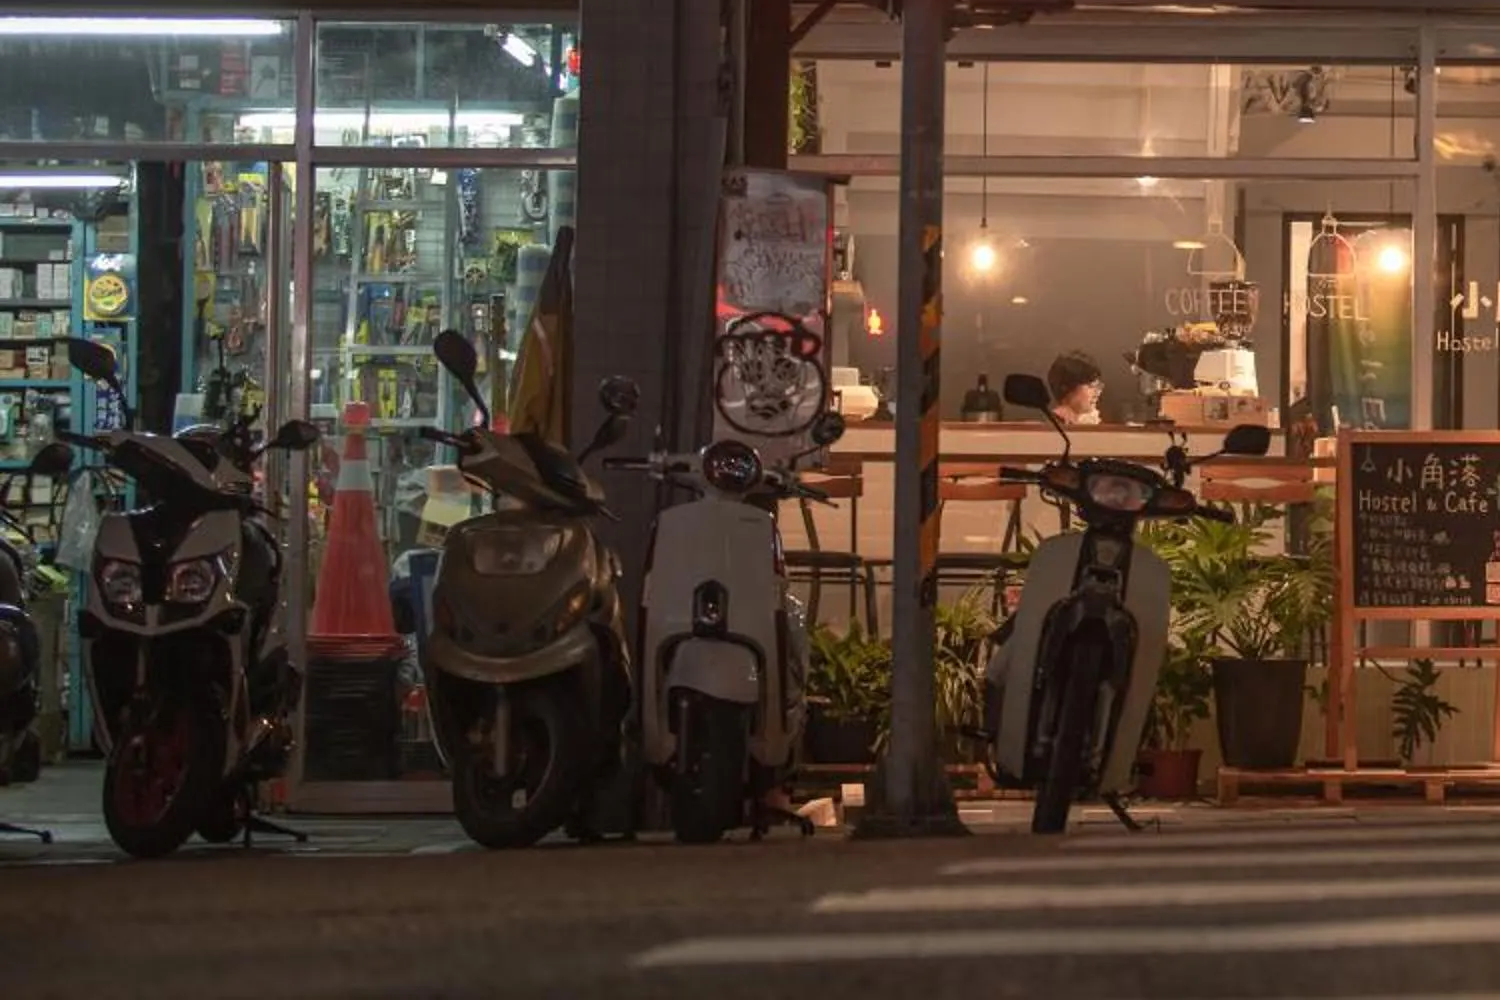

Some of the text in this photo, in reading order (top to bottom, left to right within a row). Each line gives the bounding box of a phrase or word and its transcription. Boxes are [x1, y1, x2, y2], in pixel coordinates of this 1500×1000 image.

[1165, 288, 1249, 316] COFFEE
[1437, 328, 1499, 353] Hostel
[1386, 452, 1481, 490] 小角落
[1359, 489, 1418, 513] Hostel
[1444, 491, 1489, 514] Cafe
